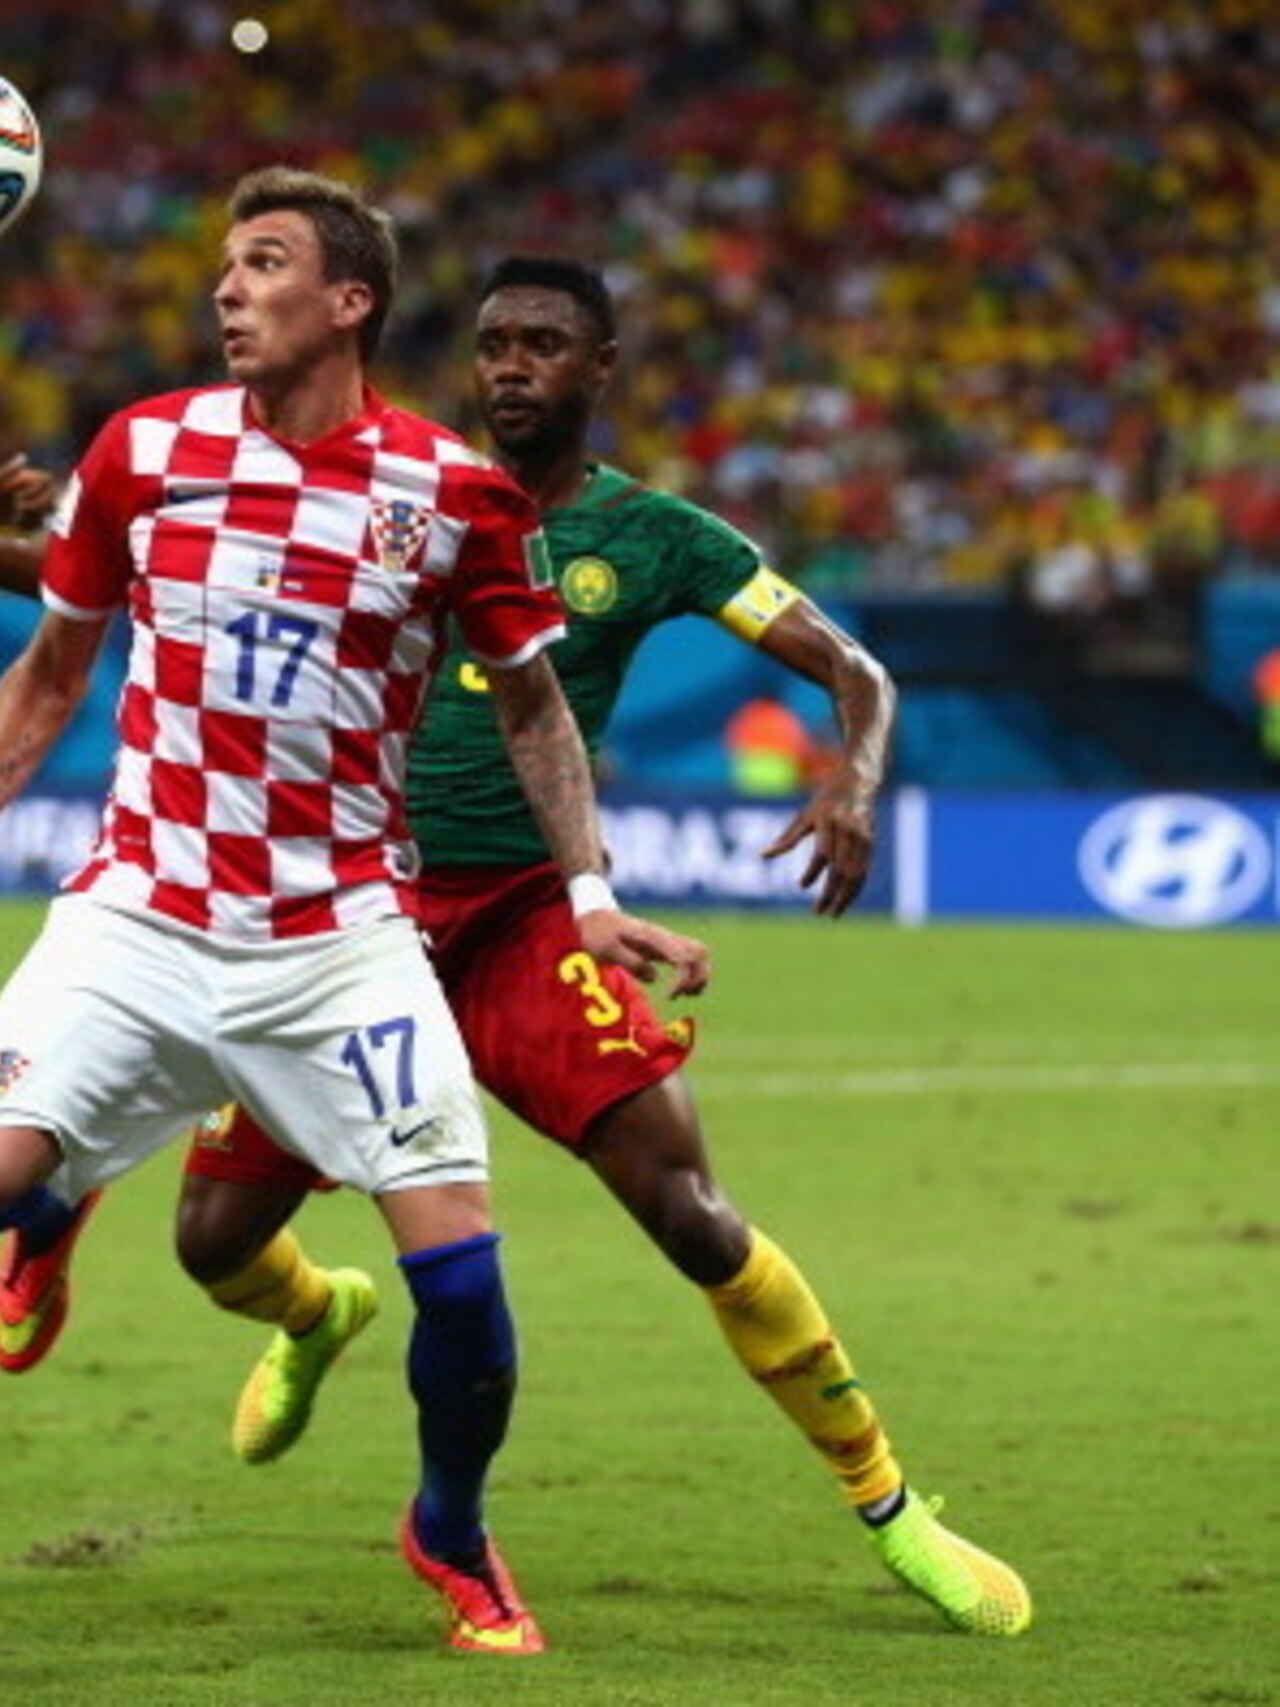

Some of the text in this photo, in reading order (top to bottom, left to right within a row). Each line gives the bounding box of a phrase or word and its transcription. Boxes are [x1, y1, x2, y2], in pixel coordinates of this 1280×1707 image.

[225, 611, 318, 707] 17
[558, 952, 622, 1027] 3
[340, 1016, 415, 1119] 17
